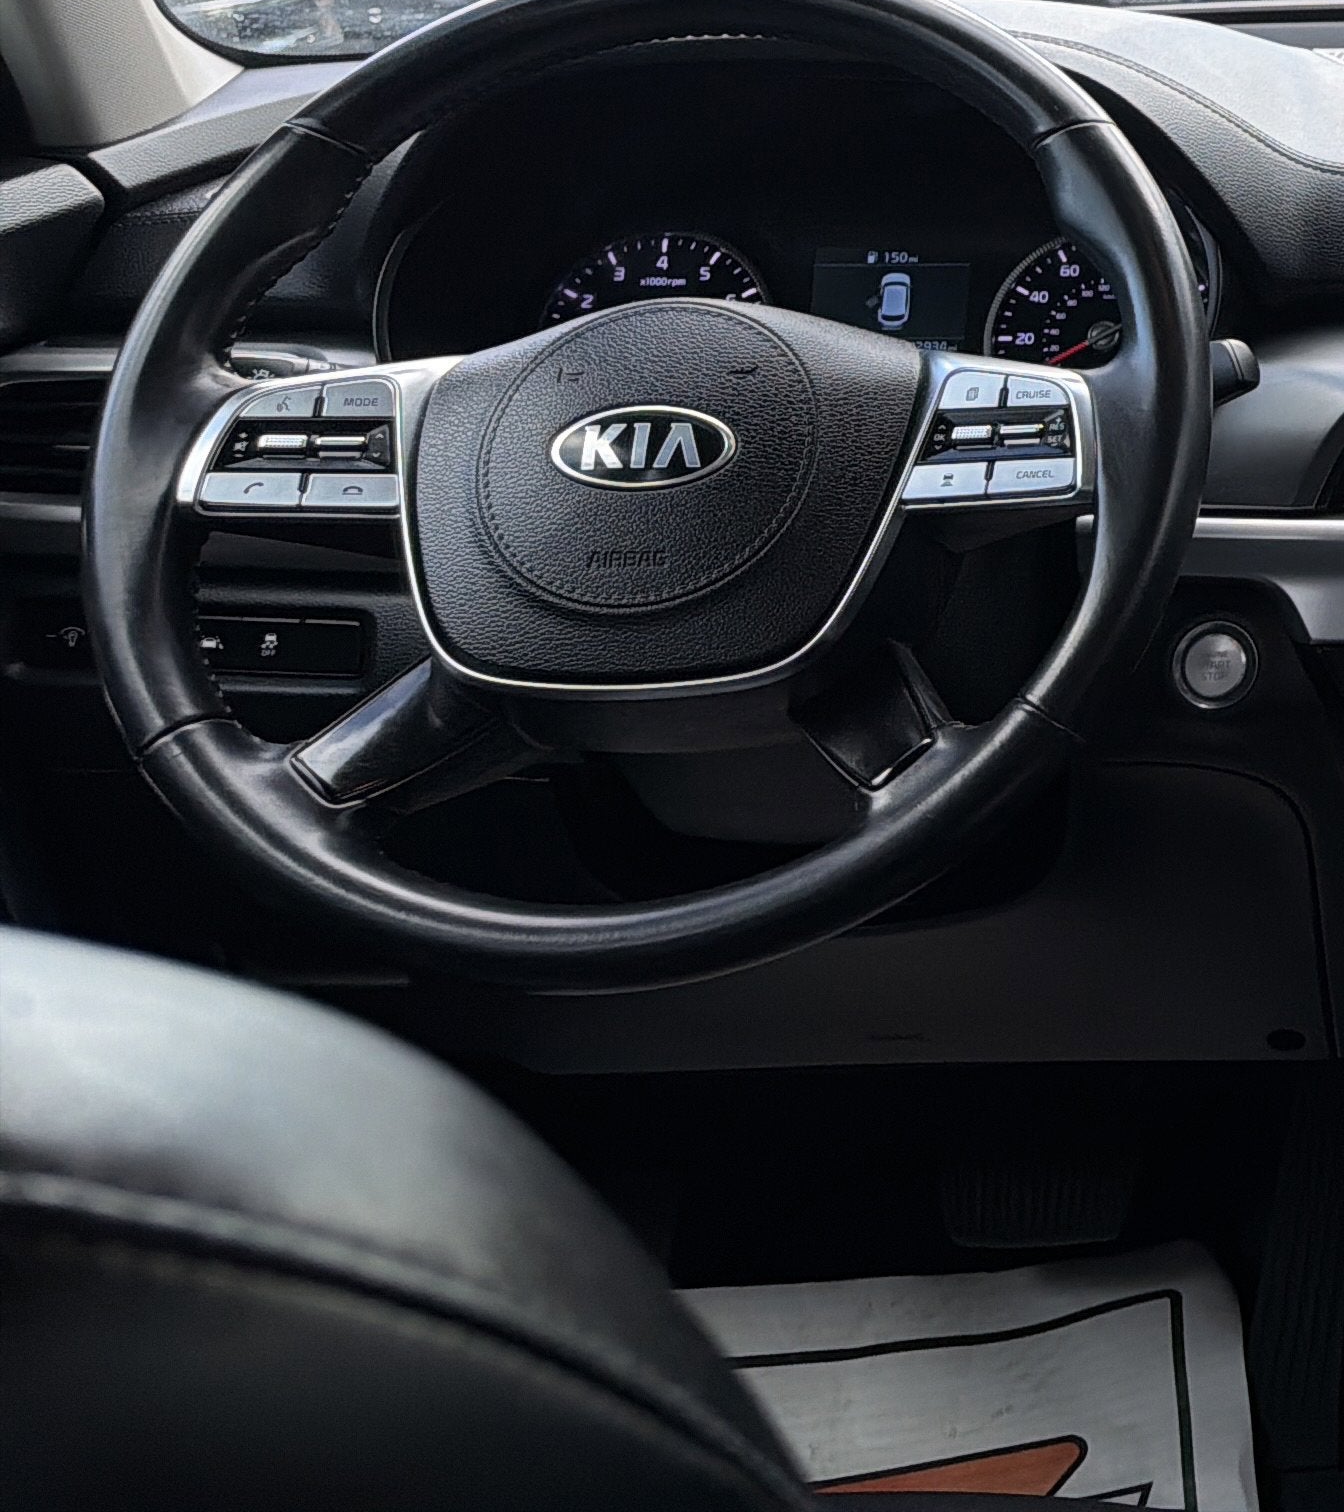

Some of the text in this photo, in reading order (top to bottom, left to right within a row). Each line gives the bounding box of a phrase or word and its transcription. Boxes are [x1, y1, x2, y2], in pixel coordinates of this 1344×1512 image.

[656, 255, 669, 271] 4
[613, 266, 625, 282] 3
[700, 266, 711, 281] 5
[1059, 264, 1080, 277] 60
[640, 276, 687, 288] x1000rpm
[581, 294, 594, 309] 2
[1029, 290, 1049, 304] 40
[1015, 332, 1035, 345] 20
[1015, 390, 1051, 400] CRUISE
[343, 397, 379, 407] MODE
[934, 433, 946, 441] OK
[580, 422, 701, 471] KIA
[1015, 469, 1054, 480] CANCEL
[587, 550, 668, 569] AIRBAG
